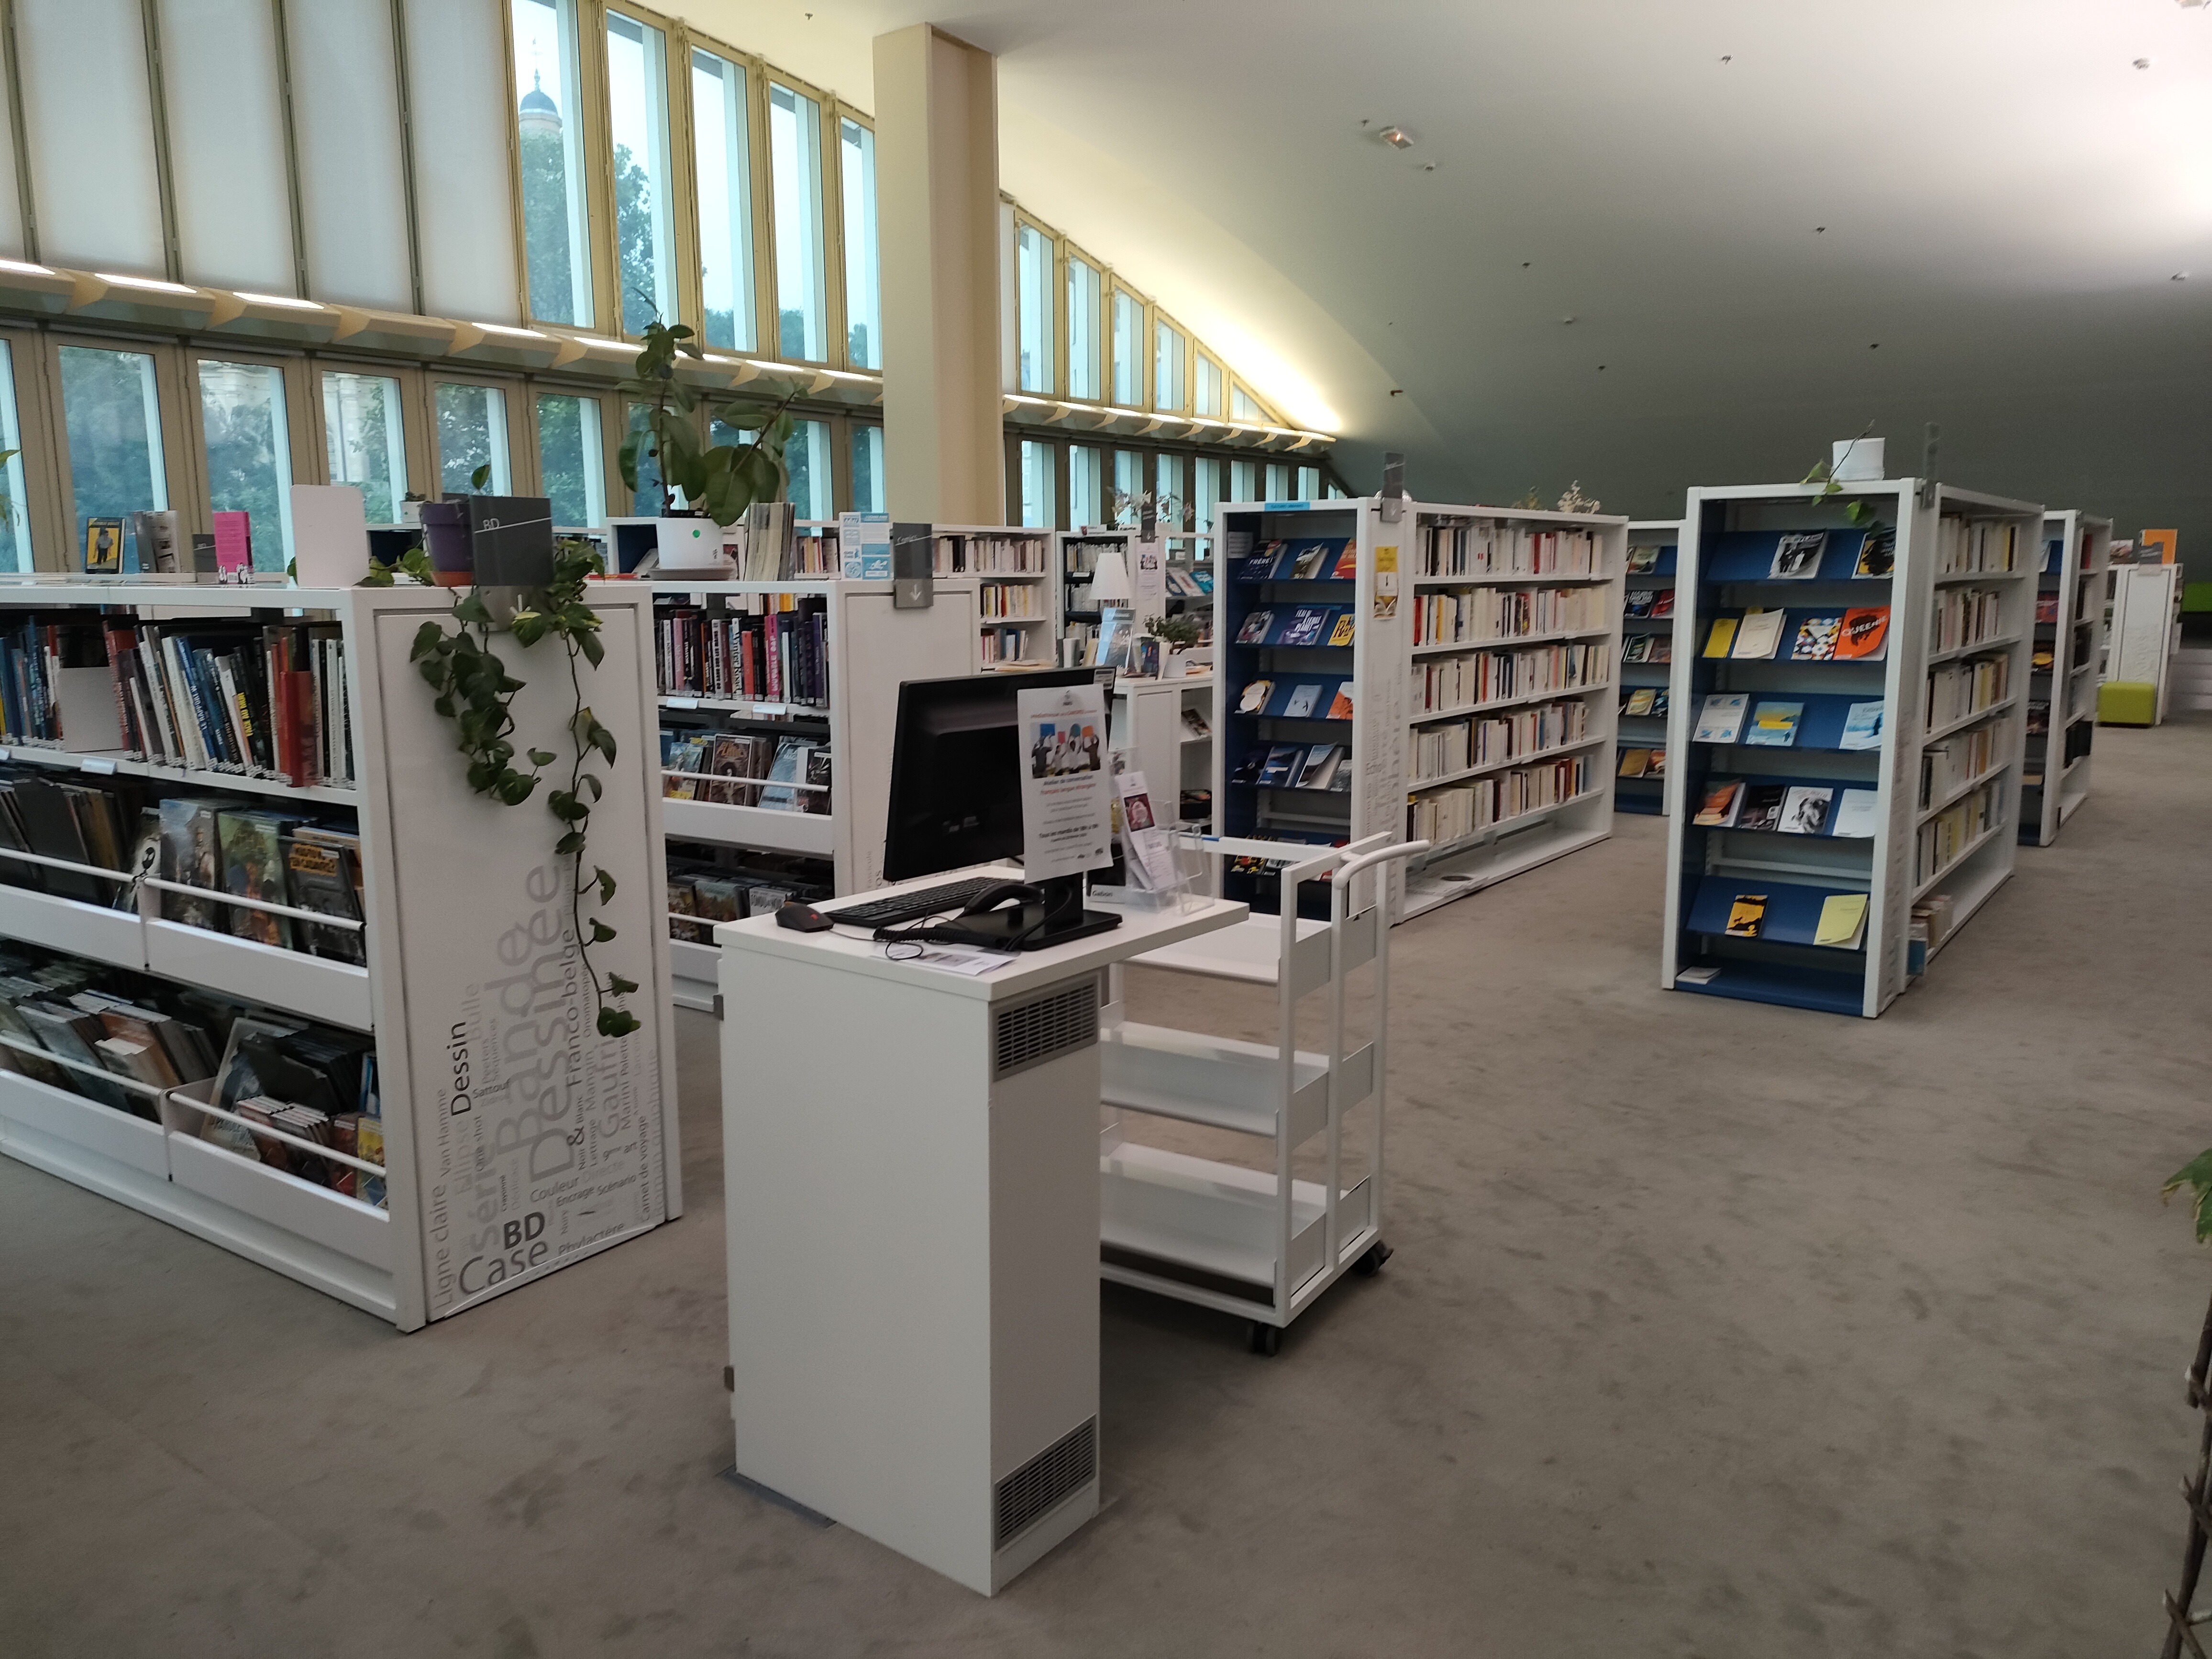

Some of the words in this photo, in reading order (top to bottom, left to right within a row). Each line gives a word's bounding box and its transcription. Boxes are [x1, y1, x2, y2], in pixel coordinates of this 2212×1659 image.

[482, 518, 500, 531] BD
[732, 630, 741, 665] Winter
[237, 692, 247, 709] MUR
[241, 709, 250, 719] AU
[244, 720, 254, 737] FACE
[461, 984, 483, 1041] Bulle
[483, 924, 543, 1155] Bande
[515, 865, 574, 1183] Dessinée
[559, 929, 582, 1087] Franco-belge
[446, 1021, 472, 1116] Dessin
[473, 1077, 512, 1099] Sattouf
[437, 1089, 450, 1147] Hamme
[620, 1081, 630, 1130] Marini
[473, 1114, 483, 1142] shot
[566, 1126, 585, 1146] &
[639, 1116, 649, 1161] voyage
[440, 1149, 451, 1178] Van
[639, 1163, 649, 1179] de
[467, 1143, 500, 1252] Série
[529, 1175, 580, 1204] Couleur
[556, 1186, 595, 1208] Encrage
[597, 1174, 637, 1196] Scénario
[639, 1183, 650, 1222] Carnet
[429, 1184, 449, 1242] claire
[503, 1212, 545, 1251] BD
[432, 1247, 456, 1309] Ligne
[458, 1240, 549, 1296] Case
